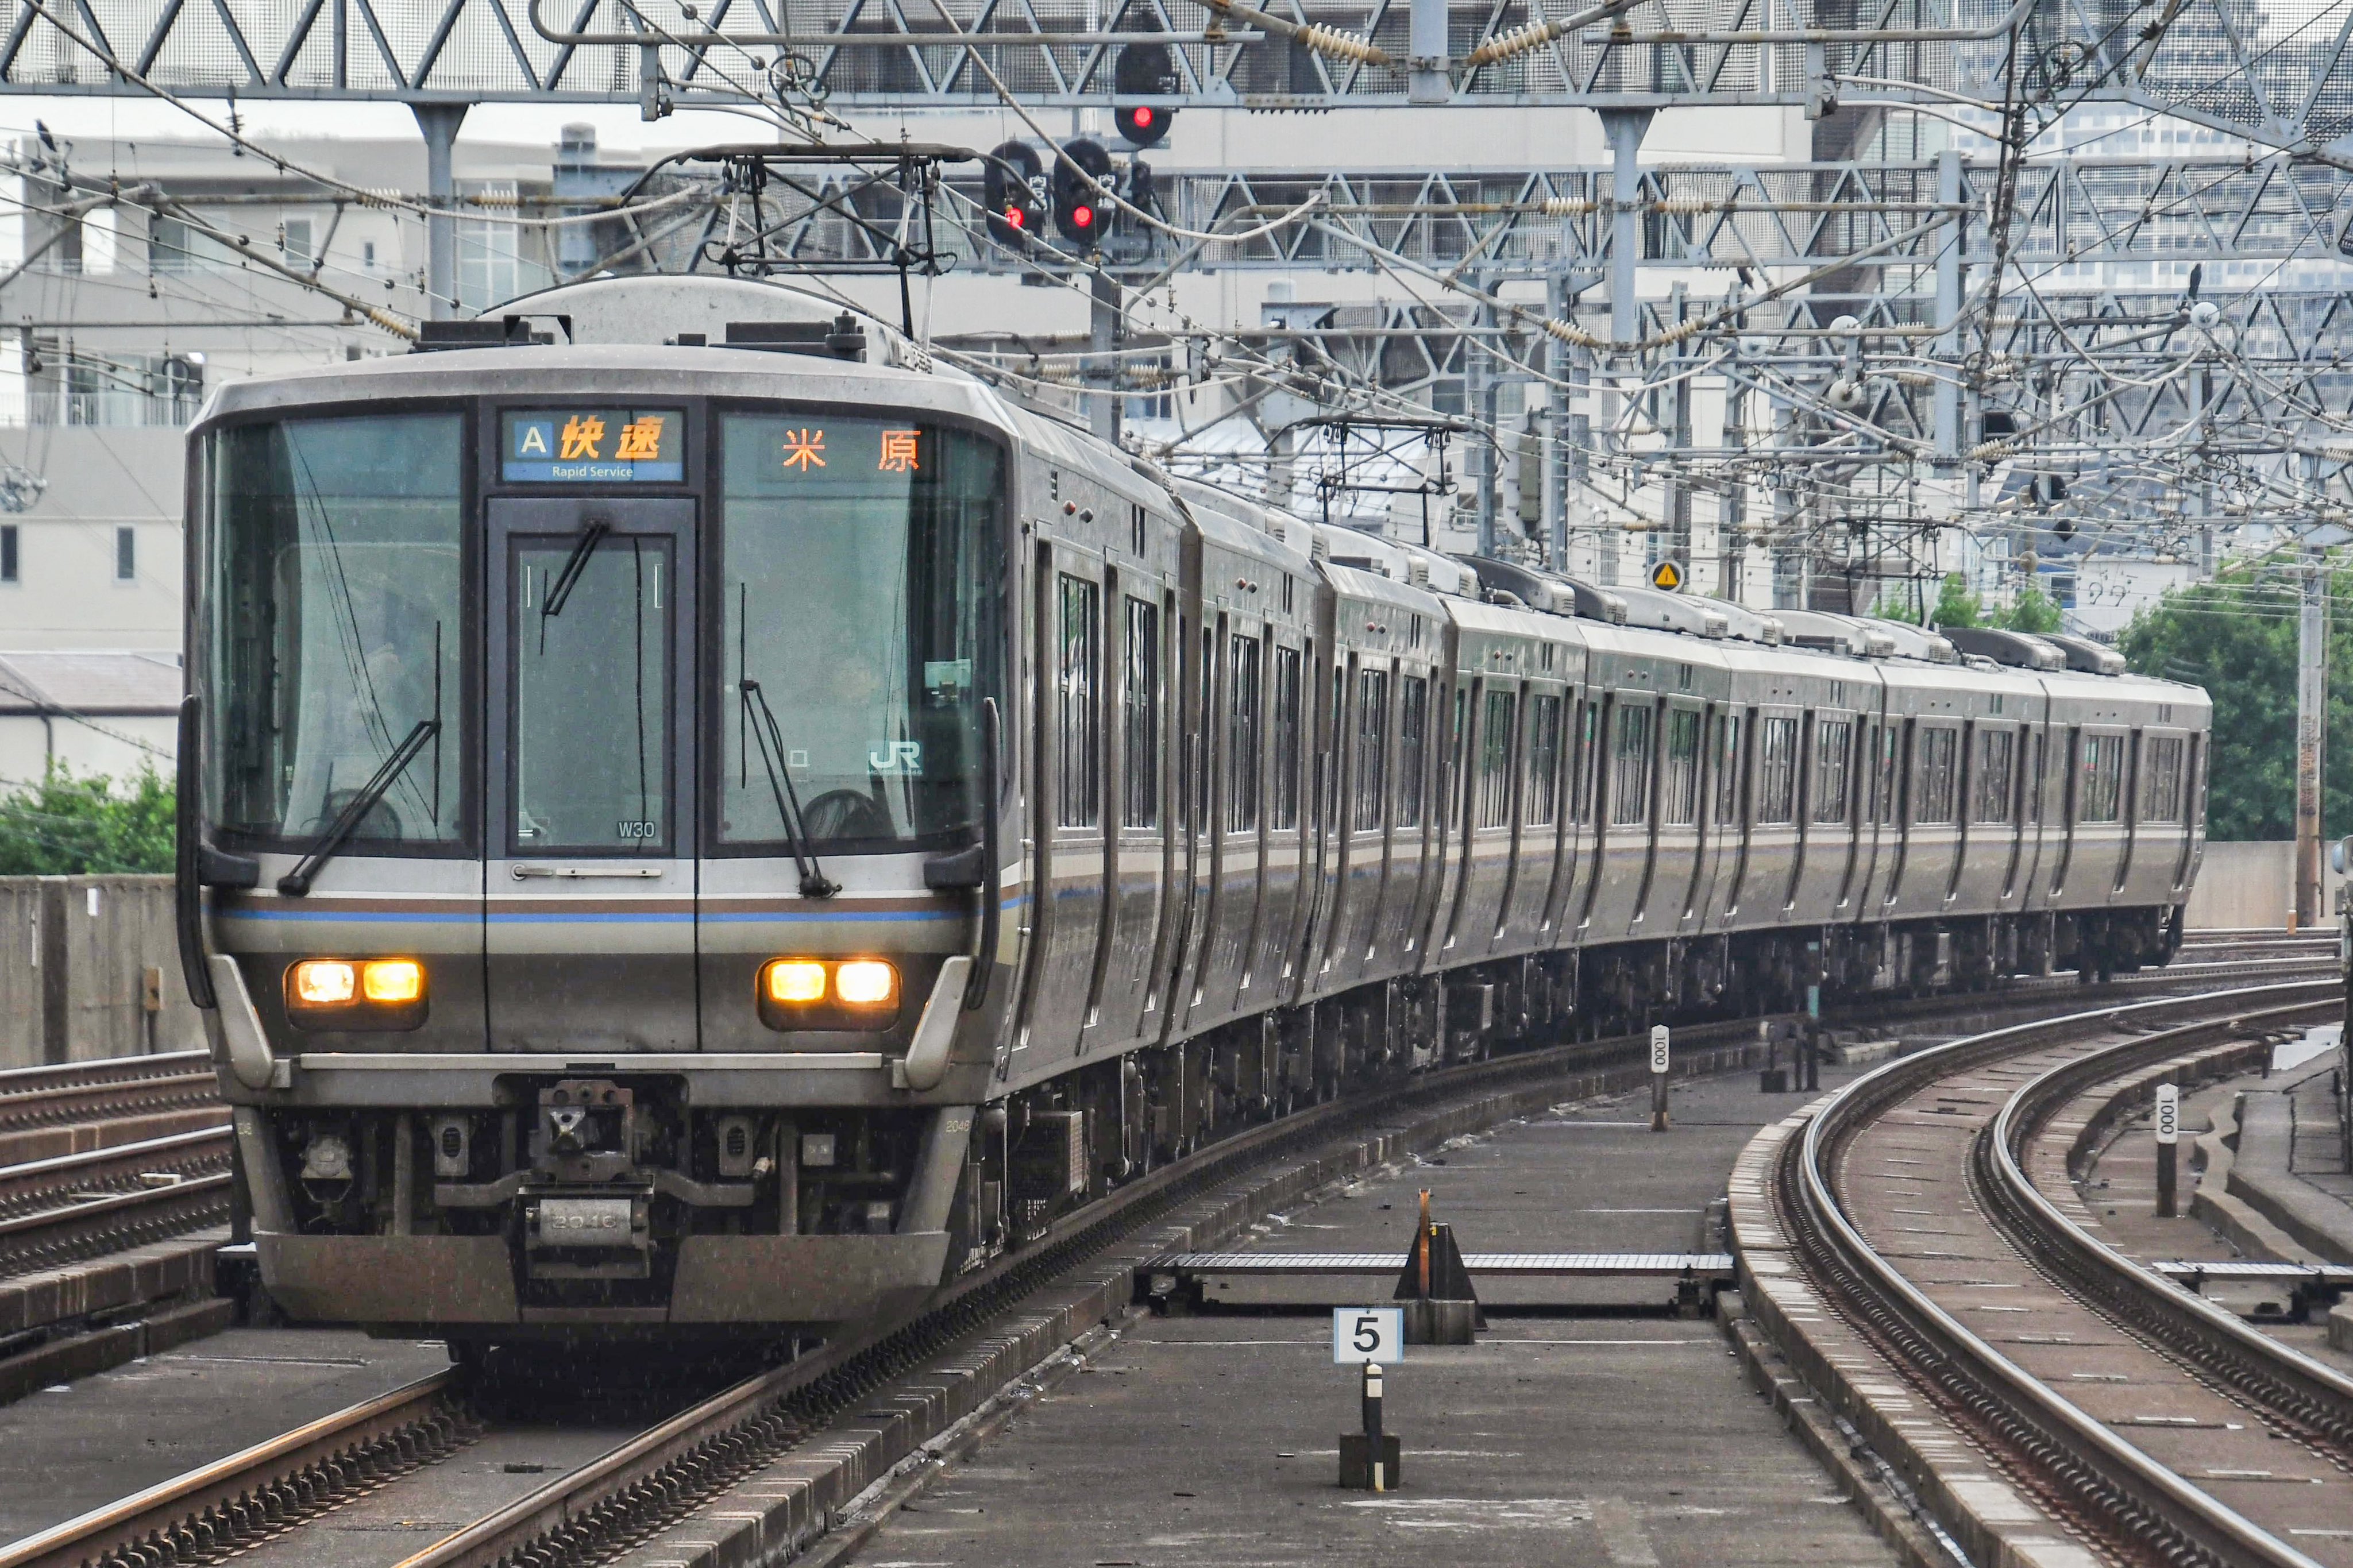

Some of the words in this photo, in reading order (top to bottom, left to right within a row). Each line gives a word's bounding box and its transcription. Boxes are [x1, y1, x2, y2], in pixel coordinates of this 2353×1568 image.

[520, 426, 547, 453] A
[560, 415, 665, 459] 快速
[783, 428, 921, 472] 米原
[553, 466, 587, 479] Rapid
[591, 466, 634, 477] Service
[870, 741, 920, 768] JR
[619, 821, 655, 837] W30
[1655, 1036, 1666, 1065] 1000
[2161, 1098, 2174, 1134] 1000
[1353, 1317, 1380, 1352] 5
